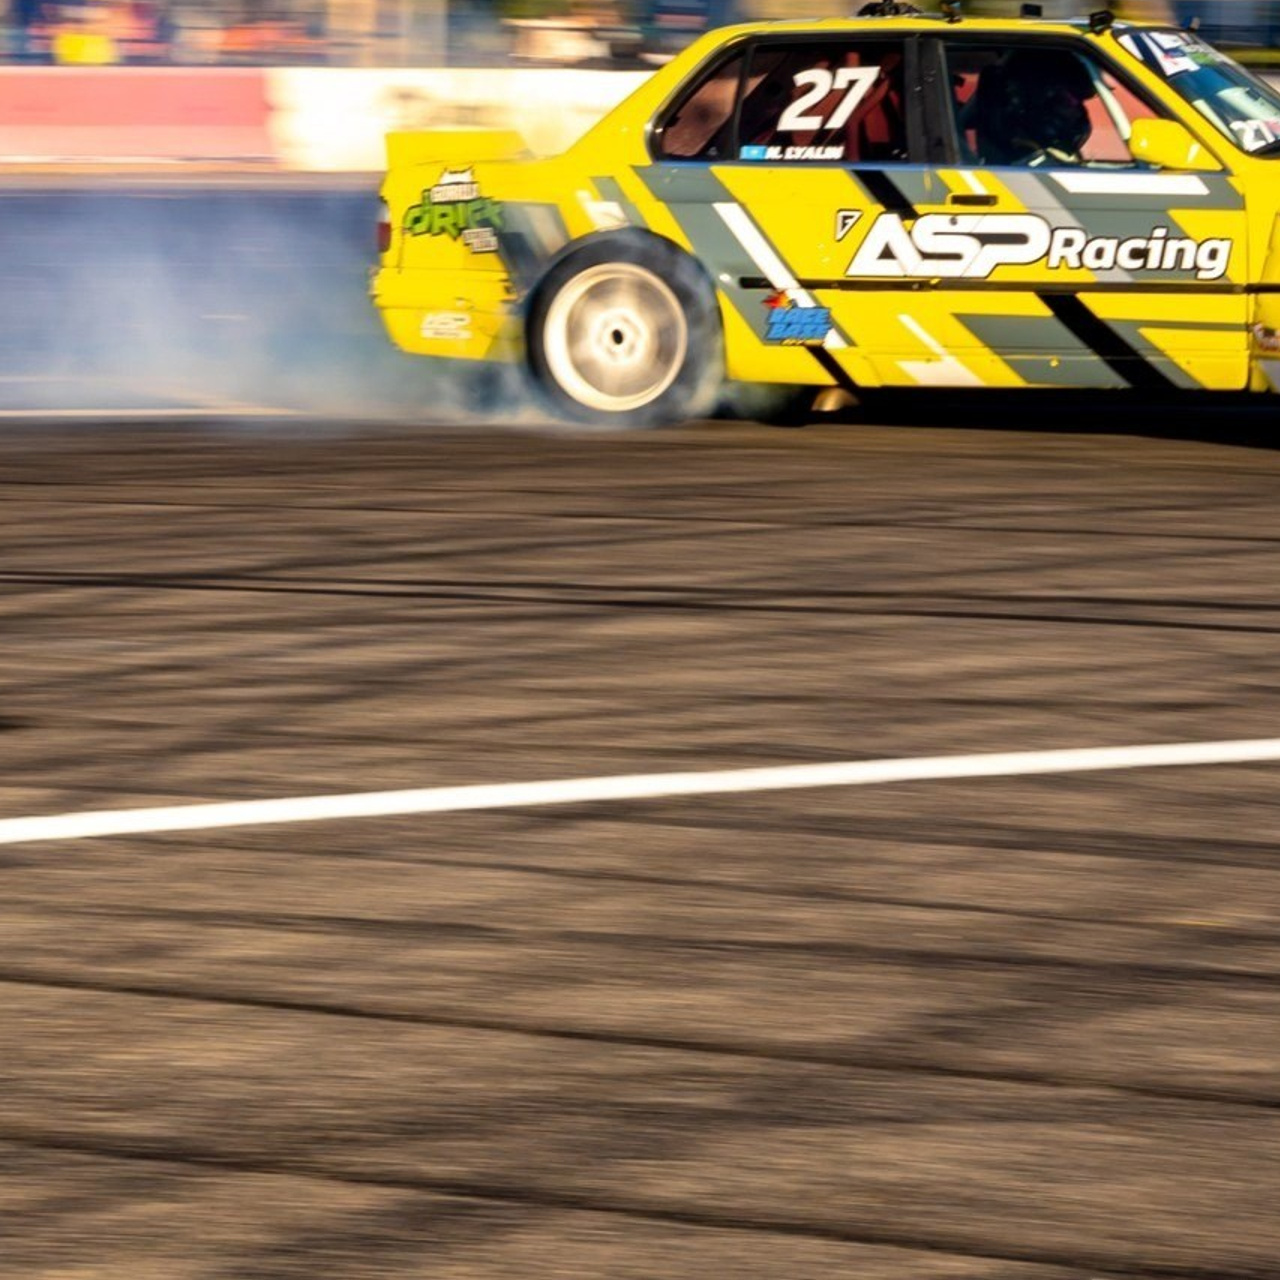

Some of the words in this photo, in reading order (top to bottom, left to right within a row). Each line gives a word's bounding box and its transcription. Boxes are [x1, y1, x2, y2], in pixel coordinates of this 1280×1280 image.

[777, 66, 881, 131] 27
[1230, 121, 1276, 152] 27
[845, 212, 1051, 279] ASP
[1047, 226, 1232, 280] Racing
